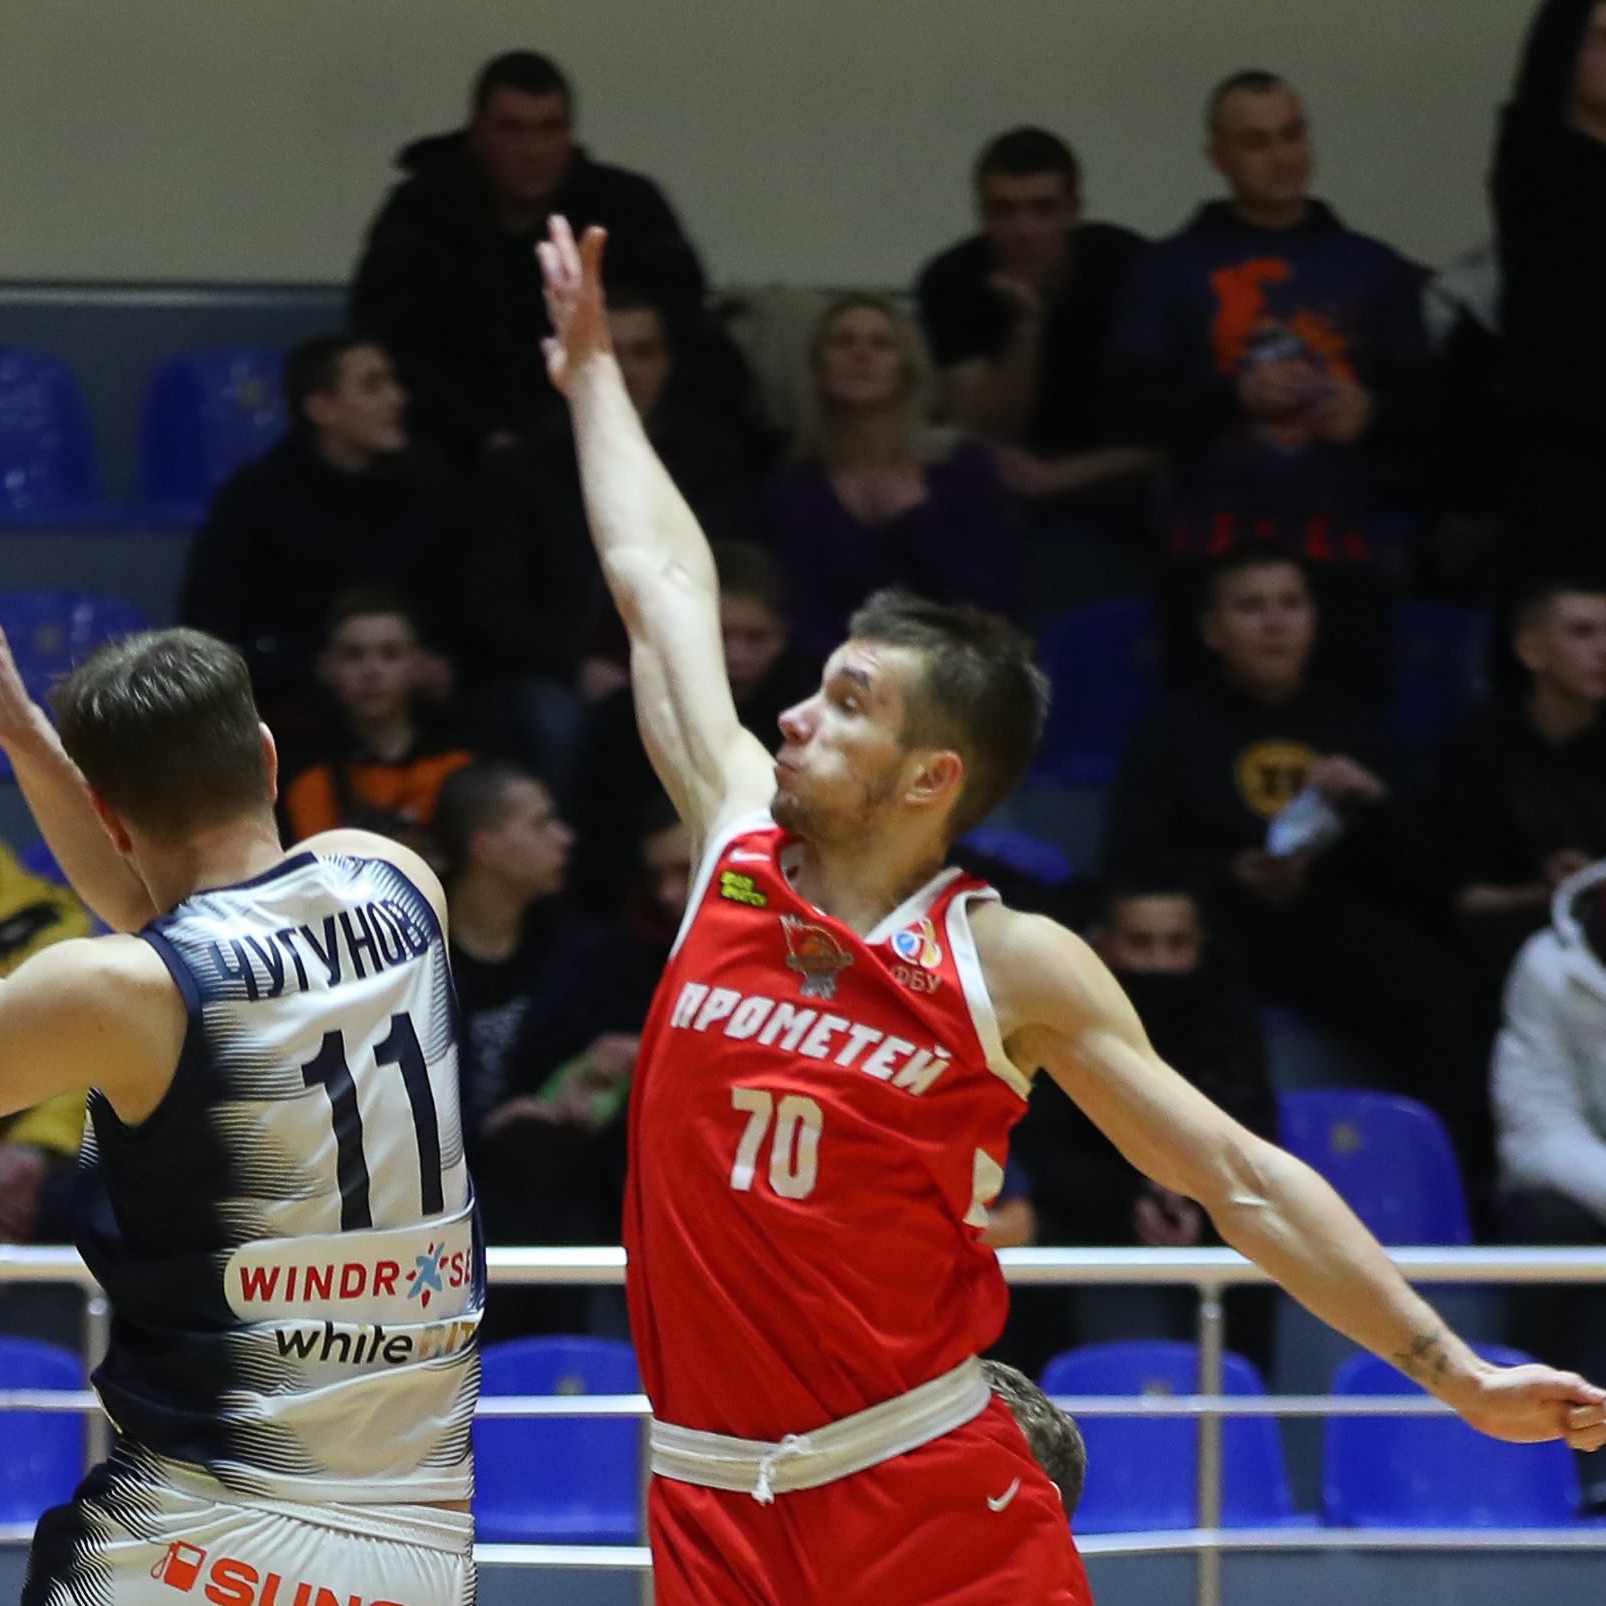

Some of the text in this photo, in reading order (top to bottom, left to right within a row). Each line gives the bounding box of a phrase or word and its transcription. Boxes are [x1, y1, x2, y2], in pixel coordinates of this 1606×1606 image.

[670, 982, 952, 1096] ПРОМЕТЕЙ
[301, 1011, 444, 1232] 11
[730, 1087, 823, 1200] 70
